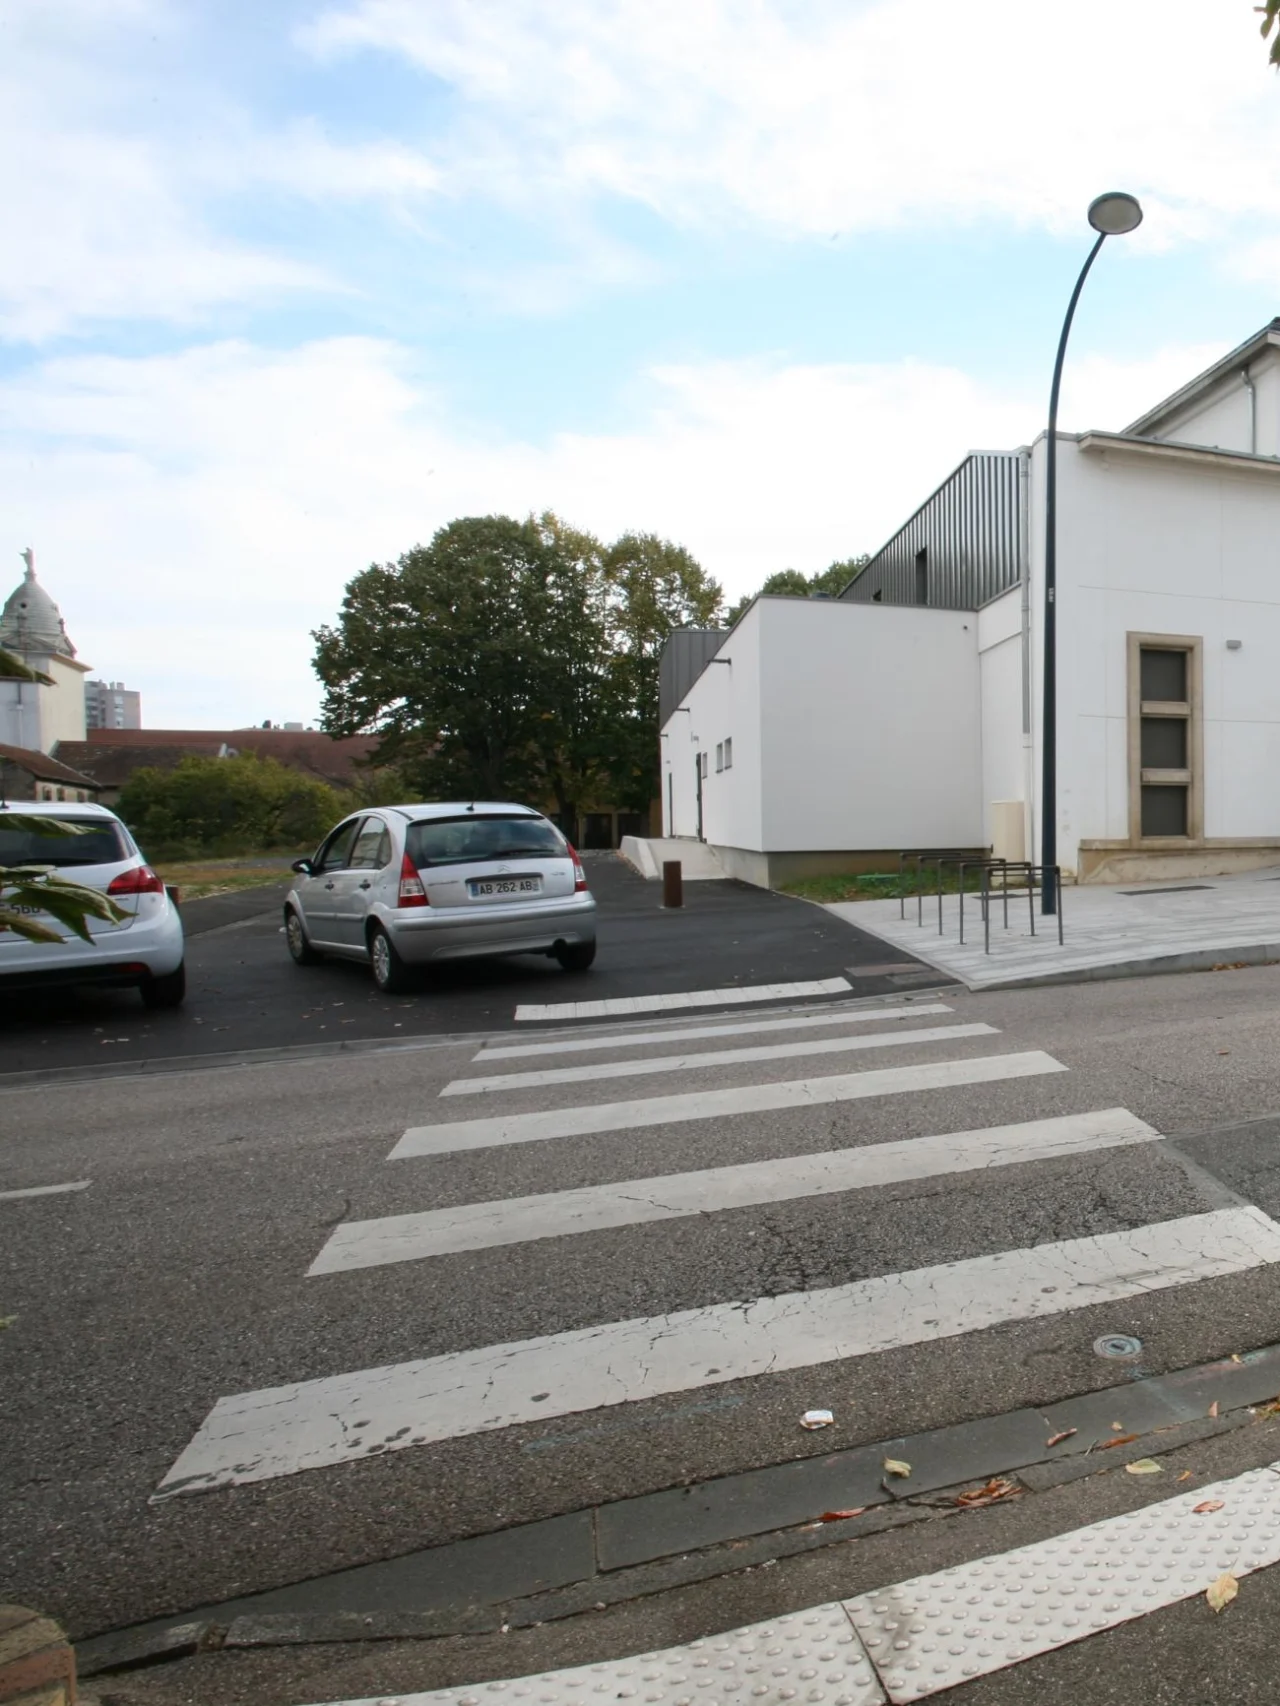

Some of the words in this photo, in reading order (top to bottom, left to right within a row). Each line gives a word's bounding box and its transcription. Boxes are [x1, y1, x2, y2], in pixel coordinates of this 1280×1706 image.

[480, 884, 493, 895] AB
[496, 881, 516, 893] 262
[520, 880, 532, 891] AB
